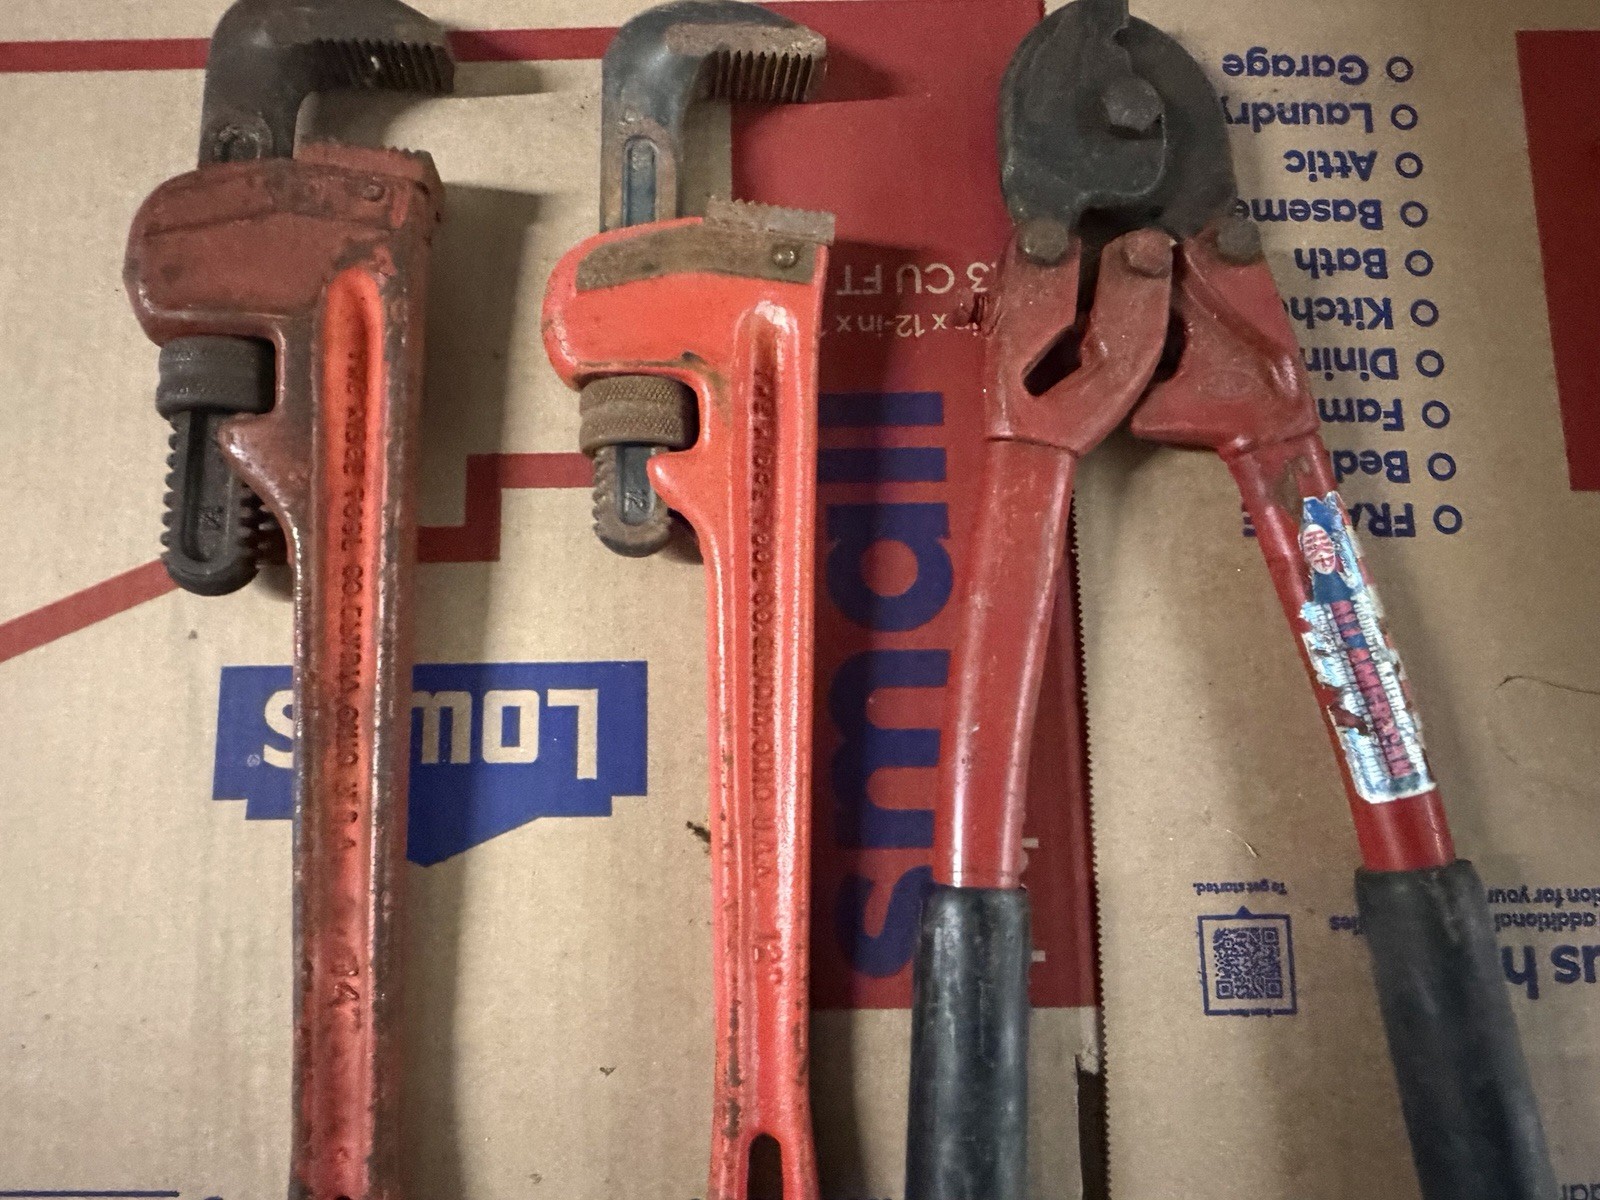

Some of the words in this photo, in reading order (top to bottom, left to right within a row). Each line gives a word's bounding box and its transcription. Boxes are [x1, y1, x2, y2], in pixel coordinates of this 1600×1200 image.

[1222, 46, 1369, 85] Garage
[1283, 150, 1378, 182] Attic
[1232, 198, 1384, 230] Baseme
[896, 262, 956, 295] CU
[1294, 248, 1389, 279] Bath
[836, 264, 883, 296] FT
[858, 313, 926, 338] 12-in
[1283, 296, 1394, 330] Kitch
[1300, 347, 1399, 381] Dinin
[1318, 398, 1405, 431] Fam
[817, 391, 954, 981] small
[1494, 911, 1597, 932] additional
